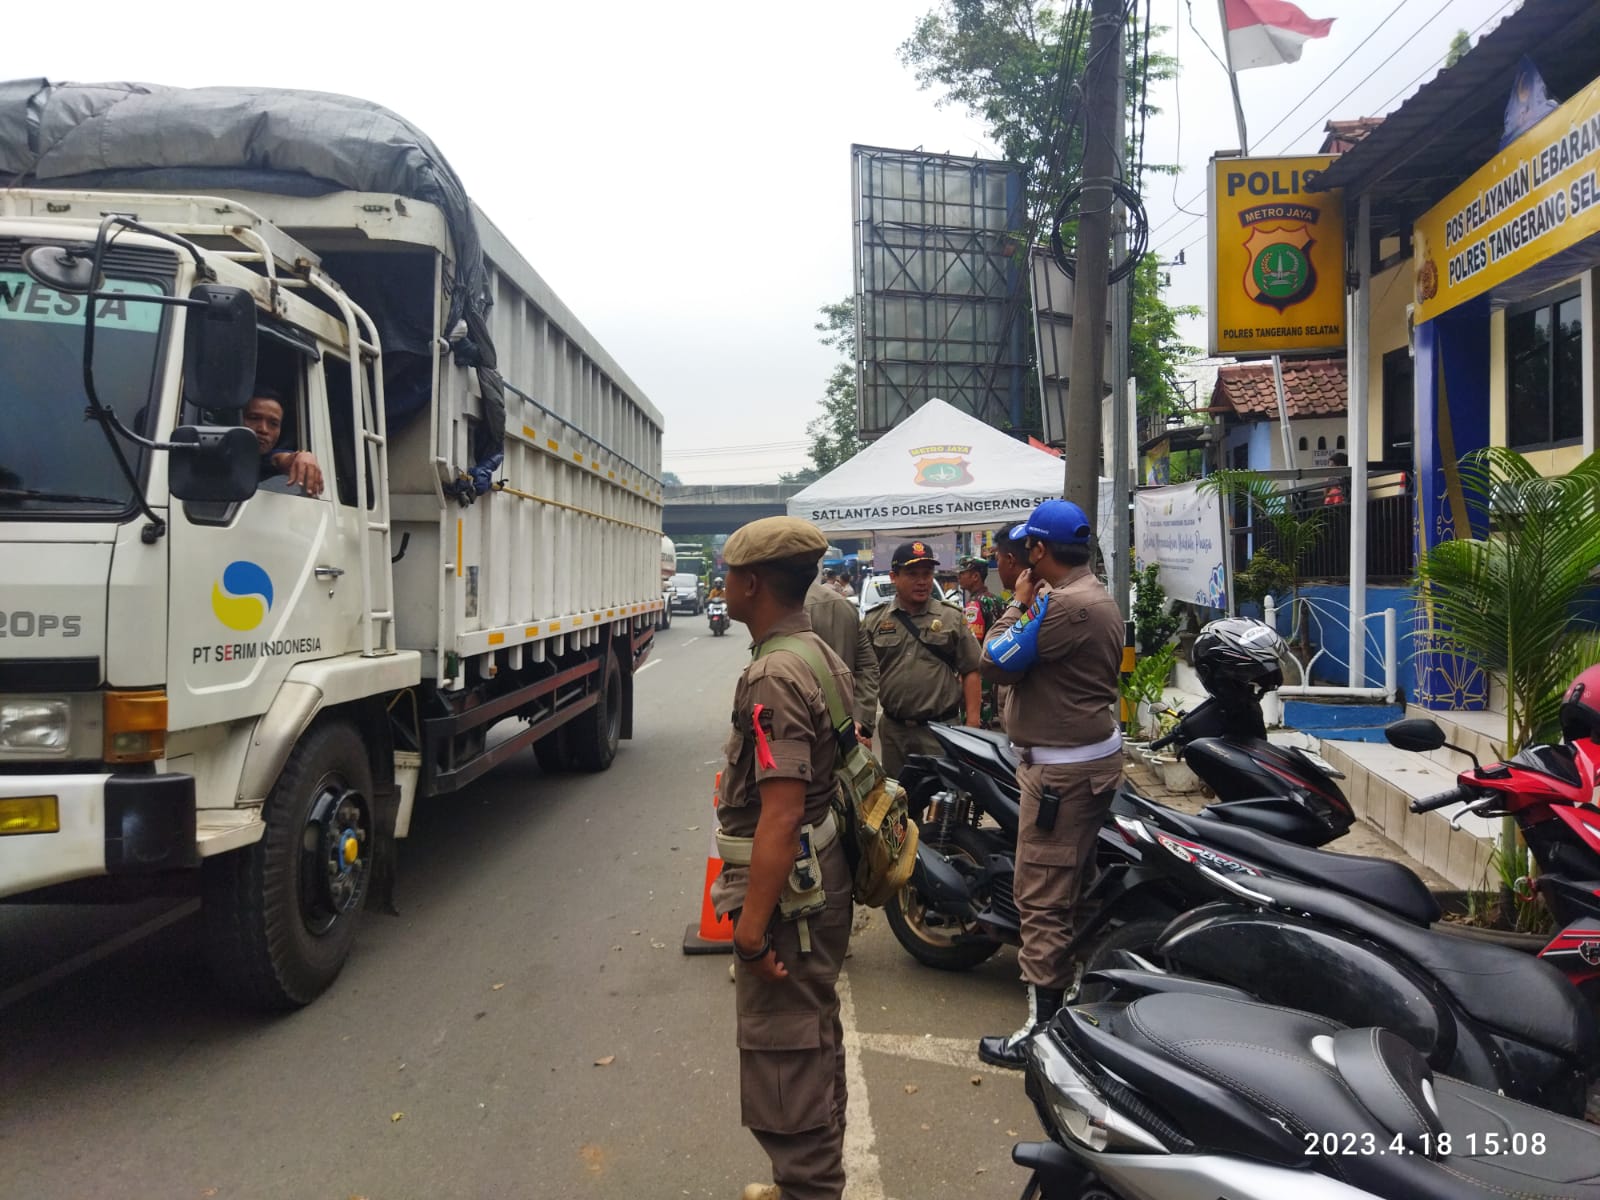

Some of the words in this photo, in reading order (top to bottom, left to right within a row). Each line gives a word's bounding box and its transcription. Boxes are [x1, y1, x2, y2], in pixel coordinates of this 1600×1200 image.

[1446, 212, 1464, 247] POS
[1466, 164, 1529, 233] PELAYANAN
[1532, 114, 1600, 187] LEBARAN
[1244, 207, 1284, 223] METRO
[1286, 208, 1313, 220] JAYA
[1449, 242, 1487, 286] POLRES
[1489, 191, 1566, 262] TANGERANG
[1223, 328, 1254, 340] POLRES
[1256, 326, 1303, 338] TANGERANG
[1305, 325, 1340, 336] SELATAN
[911, 446, 945, 456] METRO
[947, 446, 969, 454] JAYA
[812, 506, 889, 521] SATLANTAS
[892, 503, 943, 517] POLRES
[948, 498, 1031, 513] TANGERANG
[193, 646, 211, 664] PT
[215, 642, 257, 662] SERIM
[260, 637, 321, 657] INDONESIA
